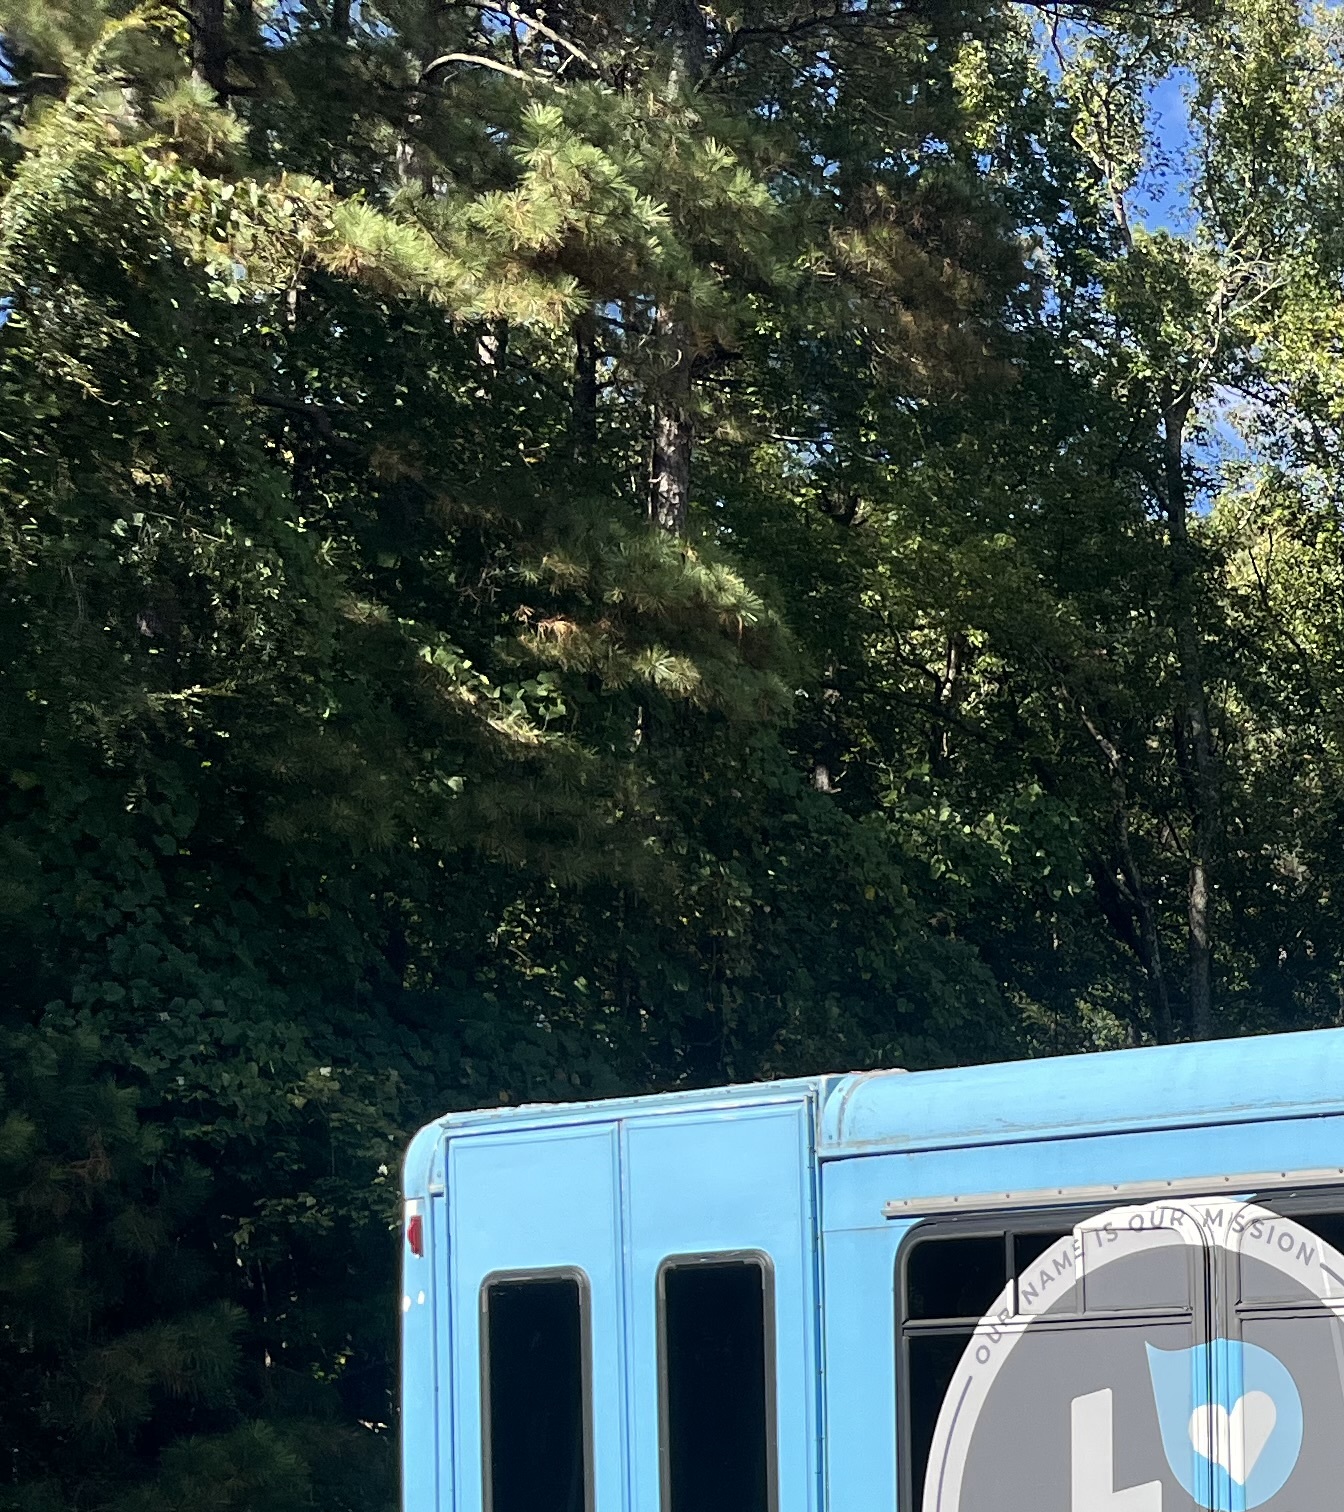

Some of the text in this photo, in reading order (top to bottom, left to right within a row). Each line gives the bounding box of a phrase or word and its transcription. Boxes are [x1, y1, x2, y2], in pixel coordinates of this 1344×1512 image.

[976, 1207, 1315, 1365] OUR NAME IS OUR MISSION
